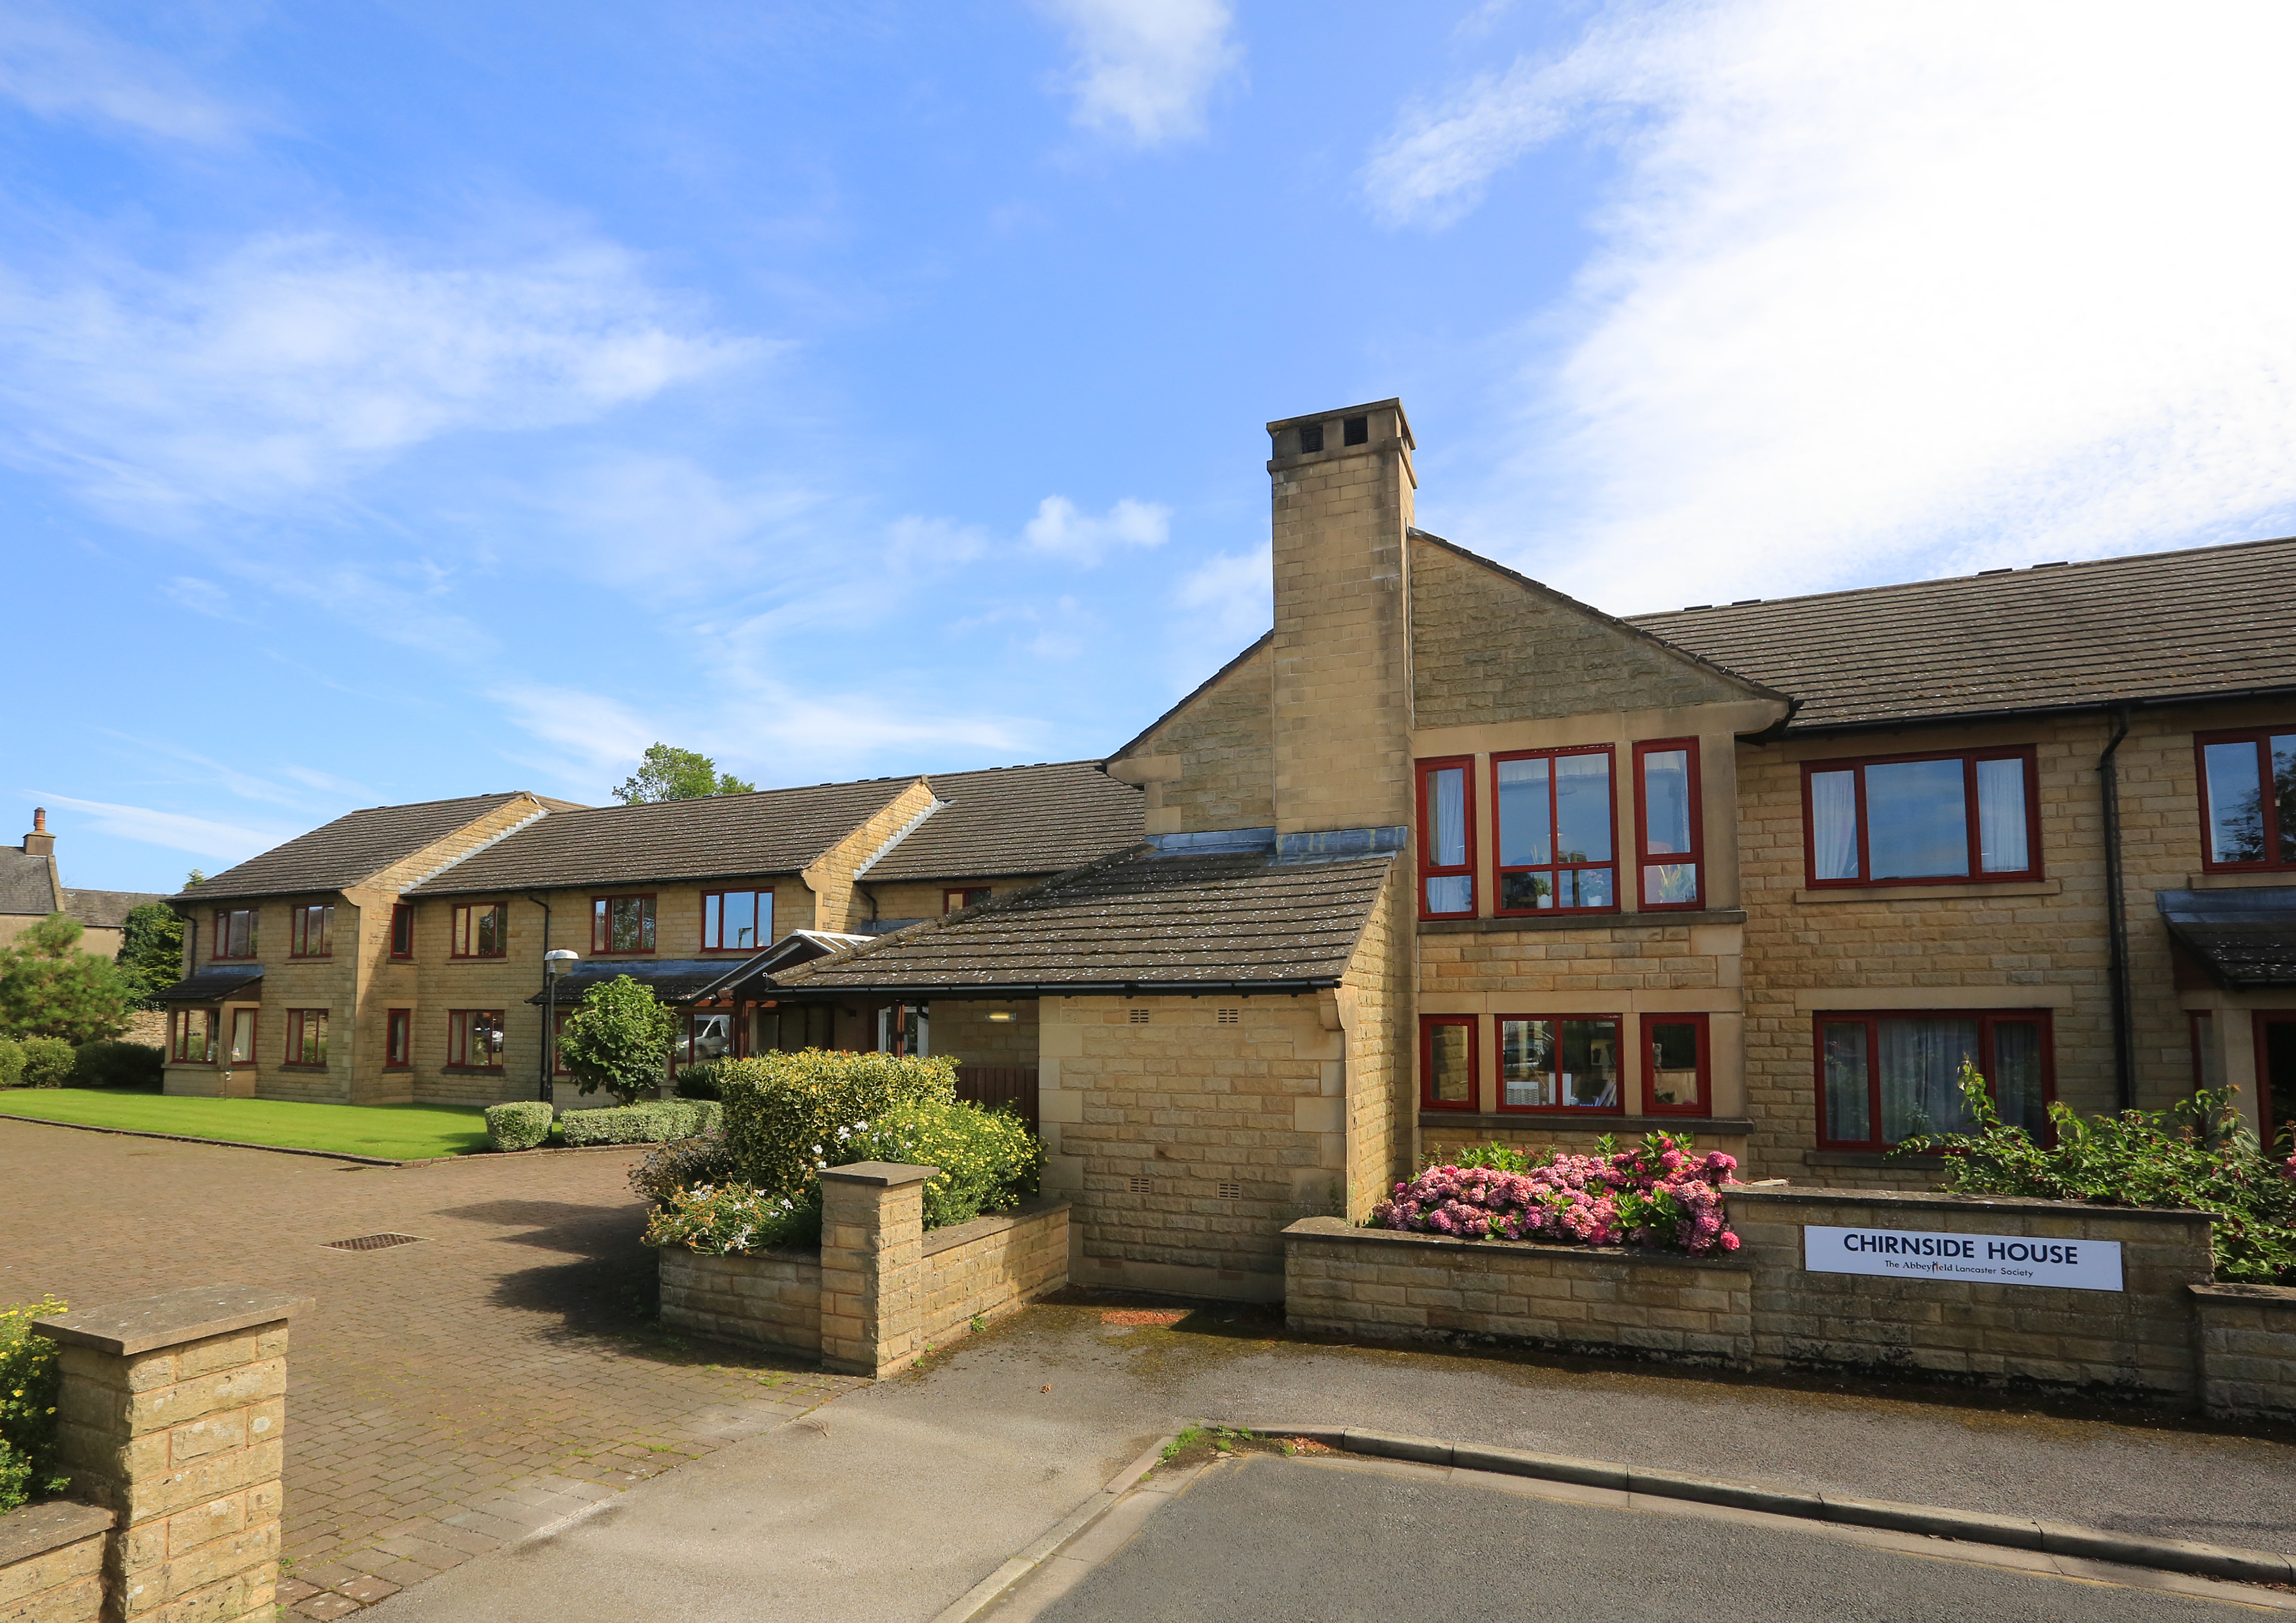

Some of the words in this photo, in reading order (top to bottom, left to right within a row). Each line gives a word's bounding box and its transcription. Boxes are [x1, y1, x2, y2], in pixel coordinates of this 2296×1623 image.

[1843, 1234, 1975, 1258] CHIRNSIDE
[1988, 1241, 2078, 1264] HOUSE
[1903, 1261, 1953, 1274] Abbeyfield
[1955, 1264, 1997, 1274] Lancaster
[2001, 1268, 2034, 1278] Society
